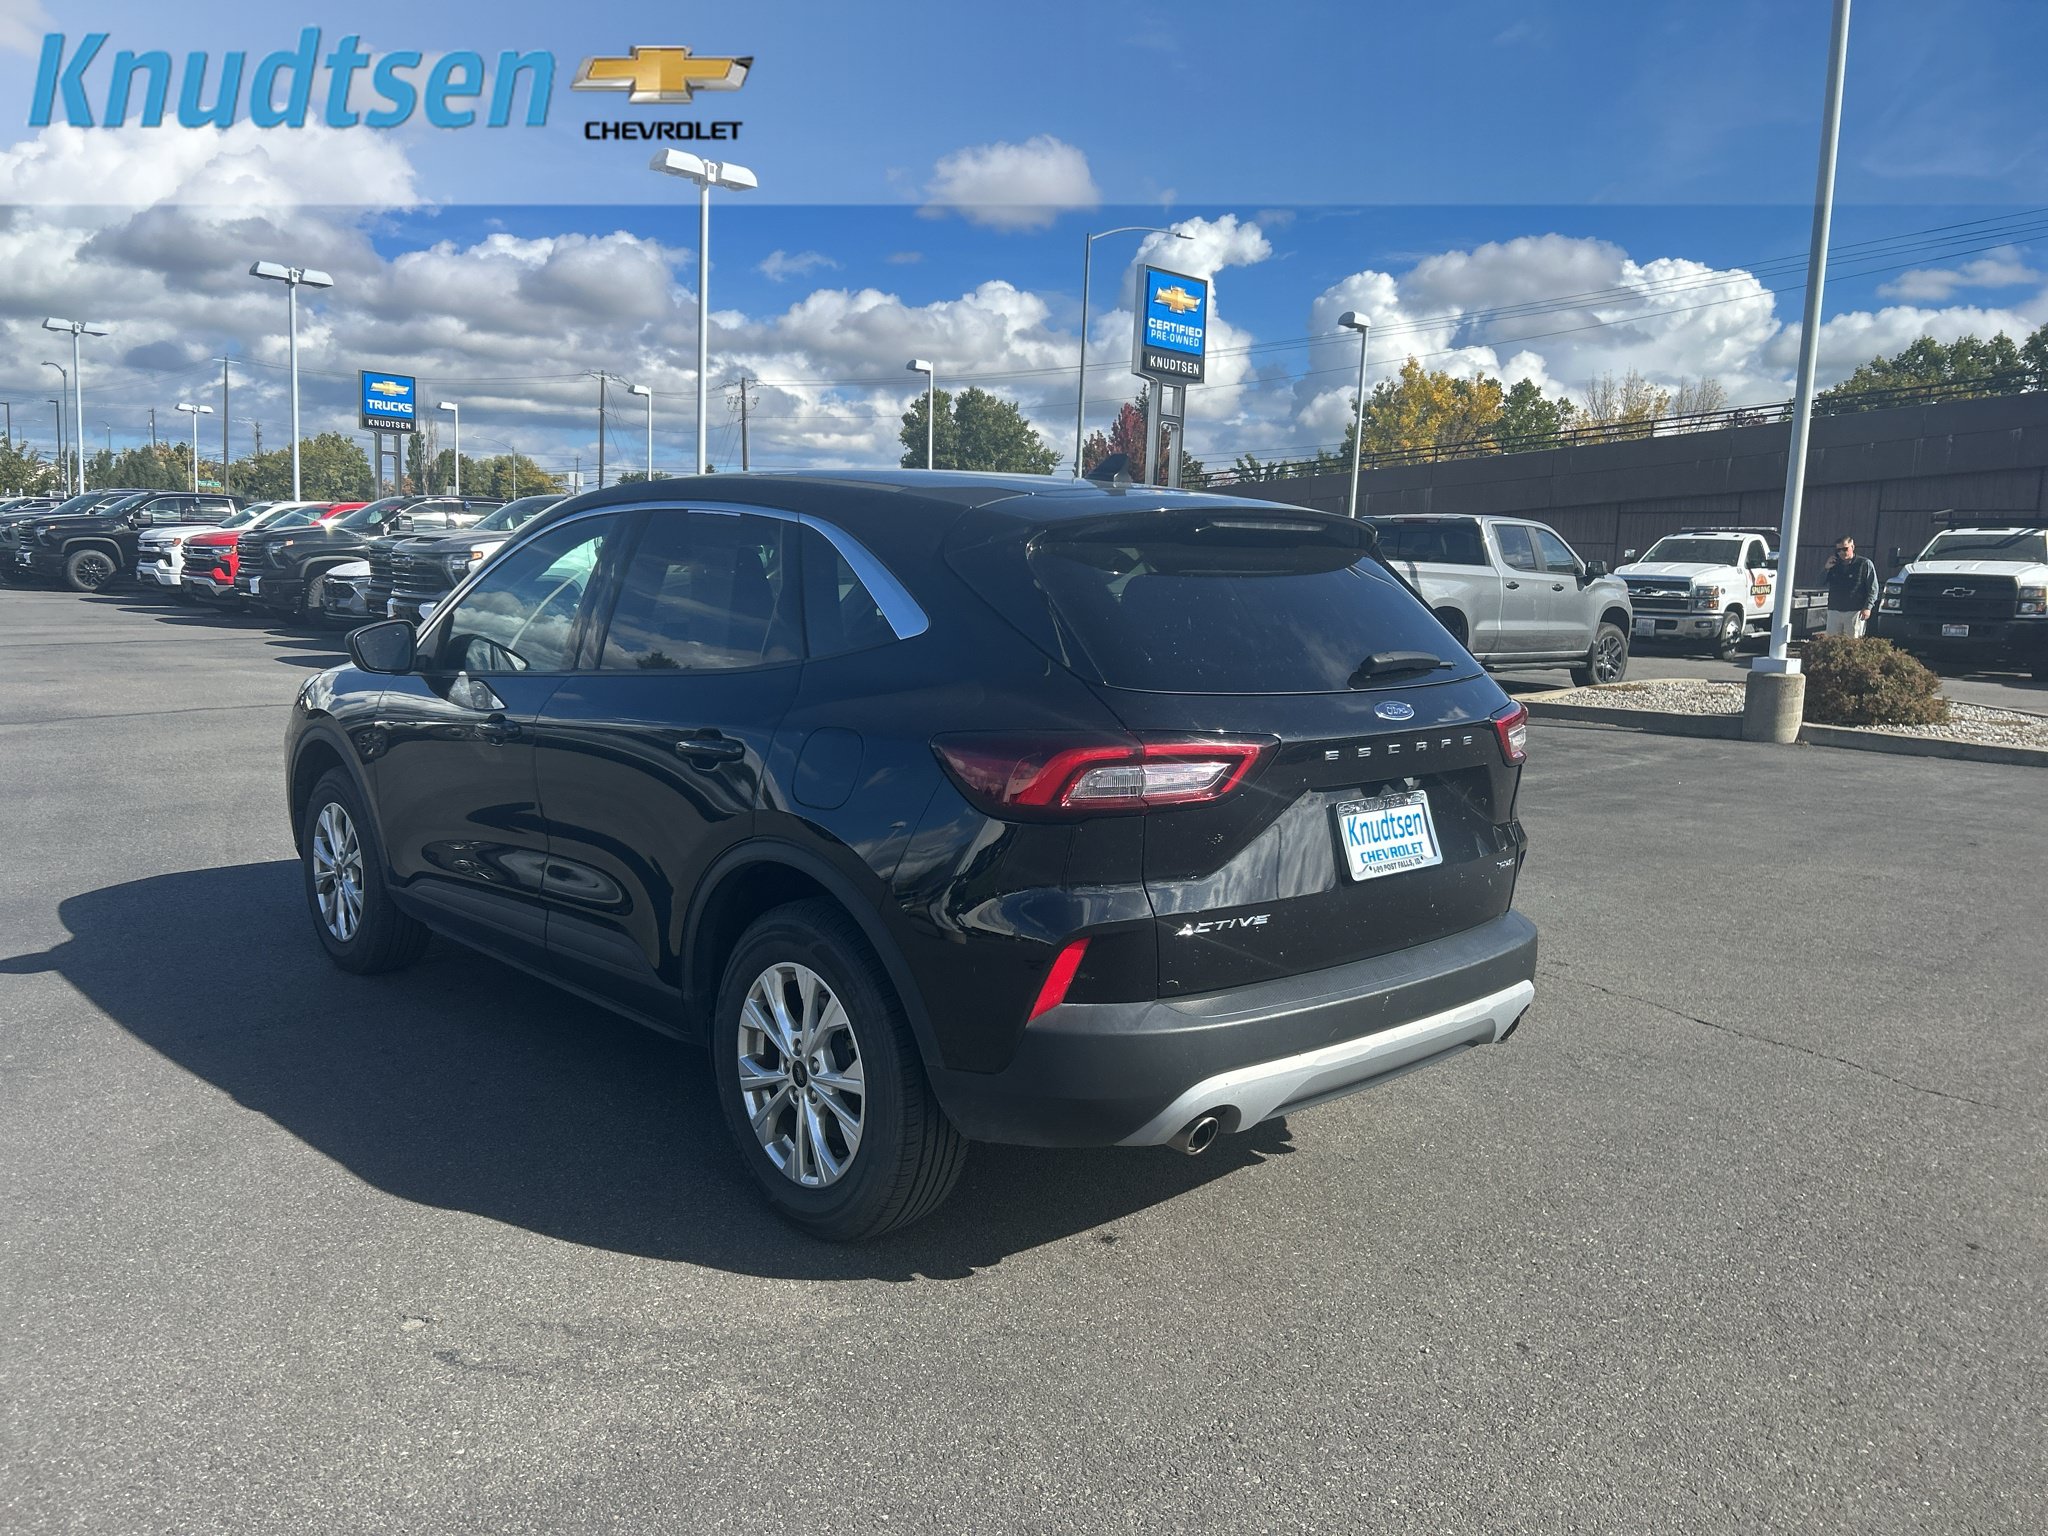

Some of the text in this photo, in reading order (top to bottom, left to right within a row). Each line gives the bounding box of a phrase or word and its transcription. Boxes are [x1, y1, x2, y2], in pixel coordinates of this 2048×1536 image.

[1148, 317, 1203, 338] CERTIFIED
[1151, 329, 1200, 347] PRE-OWNED
[1150, 355, 1200, 375] KNUDTSEN
[367, 399, 413, 413] TRUCKS
[368, 418, 411, 430] KNUDTSEN
[1324, 735, 1473, 761] ESCAPE
[1347, 810, 1424, 847] Knudtsen
[1361, 841, 1424, 863] CHEVROLET
[1384, 862, 1397, 871] POST
[1174, 914, 1271, 937] ACTIVE
